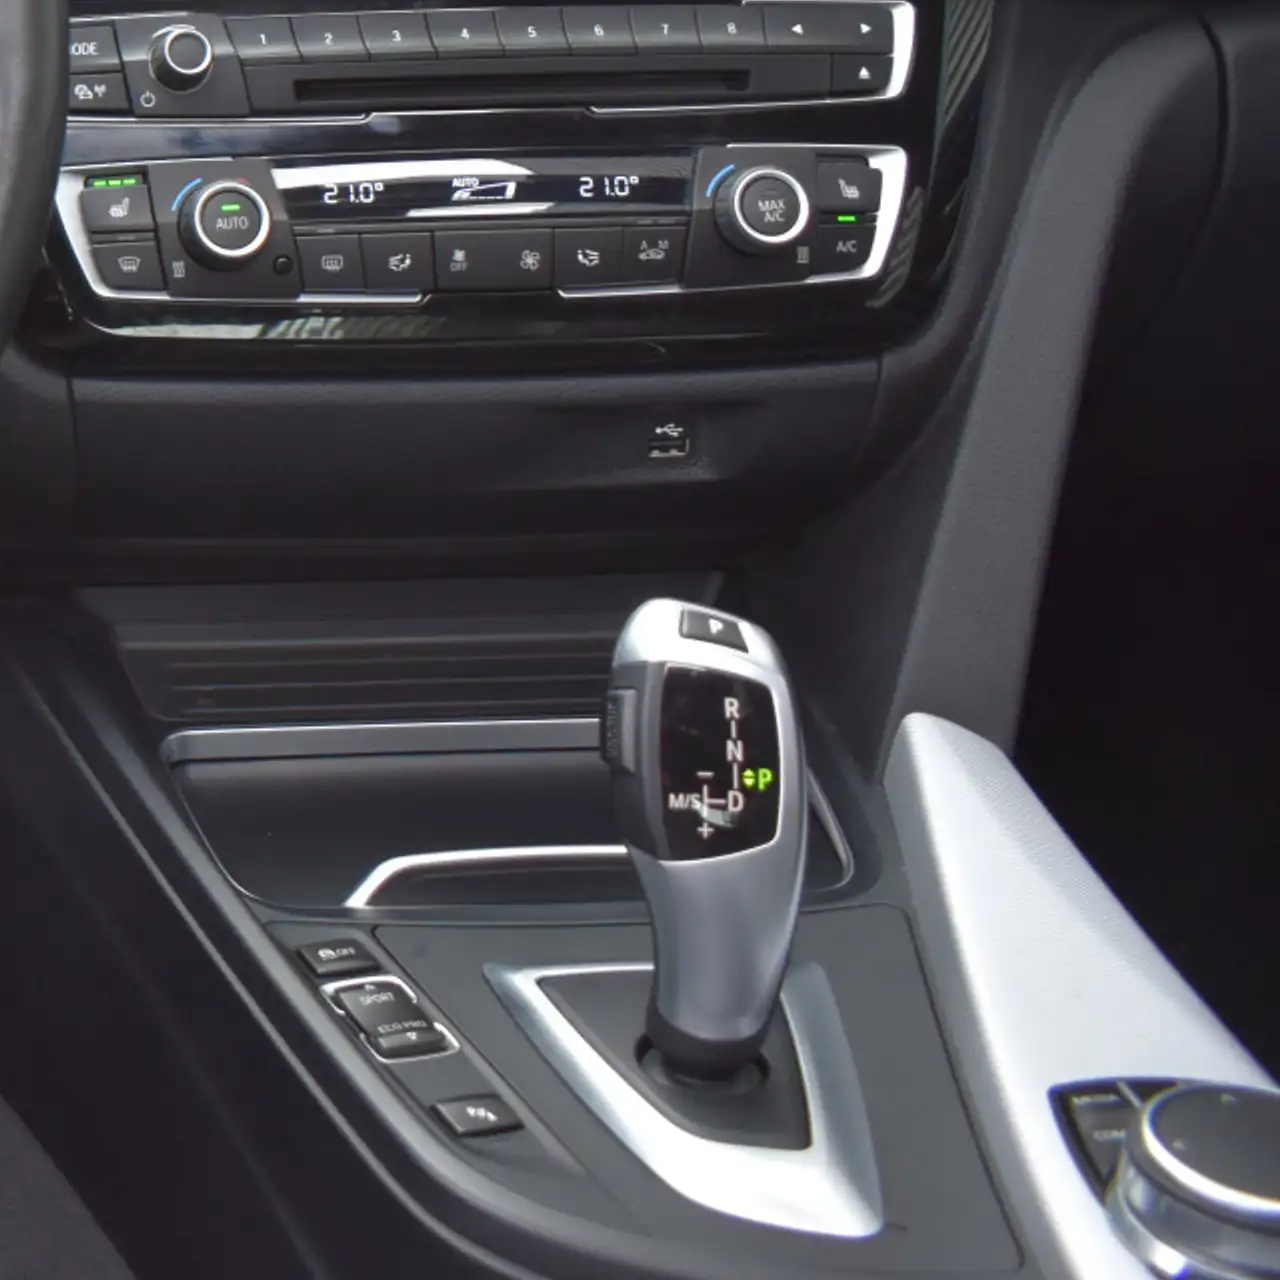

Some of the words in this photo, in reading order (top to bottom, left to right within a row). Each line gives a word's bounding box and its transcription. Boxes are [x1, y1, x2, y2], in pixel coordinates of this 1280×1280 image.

[460, 27, 470, 40] 4
[528, 25, 537, 38] 5
[594, 24, 603, 37] 6
[661, 23, 669, 36] 7
[727, 22, 737, 35] 8
[324, 32, 333, 45] 2
[392, 30, 401, 43] 3
[69, 42, 98, 55] ODE
[452, 177, 479, 188] AUTO
[758, 199, 786, 211] MAX
[215, 216, 249, 230] AUTO
[763, 211, 785, 223] A/C
[836, 239, 857, 253] A/C
[709, 619, 724, 634] P
[724, 697, 739, 719] R
[726, 740, 744, 761] N
[757, 768, 773, 790] P
[668, 793, 701, 810] M/S
[727, 790, 745, 812] D
[360, 992, 395, 1006] SPORT
